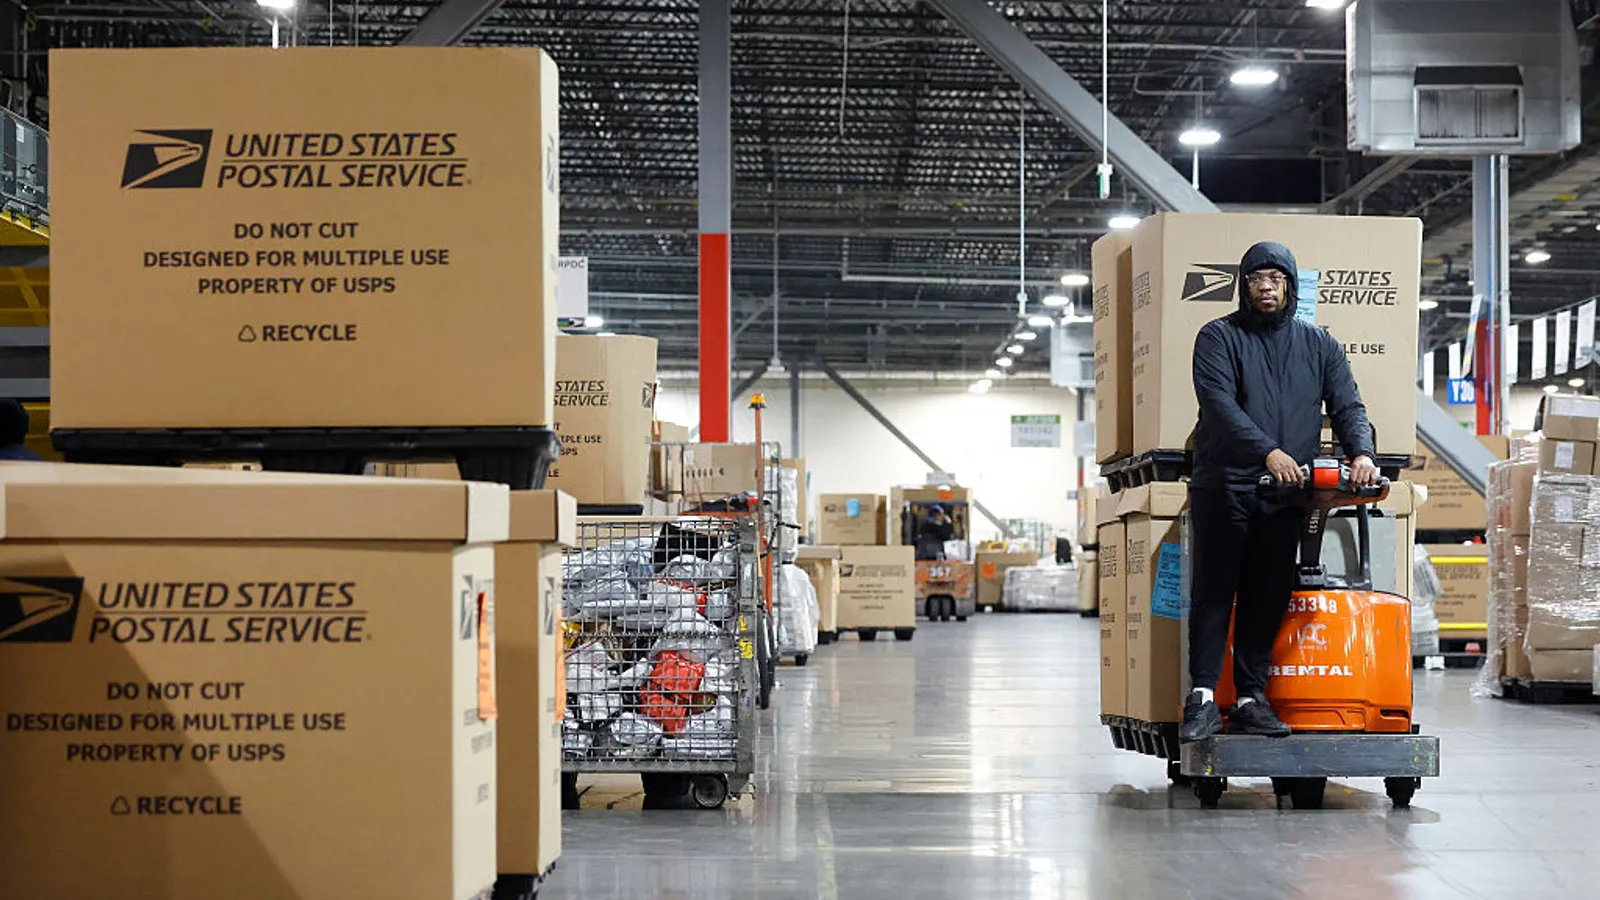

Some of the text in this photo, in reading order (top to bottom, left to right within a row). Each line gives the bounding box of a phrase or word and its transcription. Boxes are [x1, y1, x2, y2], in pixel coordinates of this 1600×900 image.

[225, 133, 457, 157] UNITED STATES
[217, 164, 467, 188] POSTAL SERVICE
[233, 222, 359, 239] DO NOT CUT
[143, 249, 449, 268] DESIGNED FOR MULTIPLE USE
[198, 276, 396, 295] PROPERTY OF USPS
[1323, 270, 1392, 287] STATES
[1317, 289, 1397, 306] SERVICE
[262, 324, 357, 342] RECYCLE
[1360, 343, 1386, 355] USE
[555, 380, 605, 392] STATES
[584, 434, 602, 444] USE
[559, 447, 578, 456] SPS
[99, 582, 356, 608] UNITED STATES
[89, 616, 366, 643] POSTAL SERVICE
[1268, 665, 1354, 676] RENTAL
[107, 682, 245, 700] DO NOT CUT
[6, 713, 347, 732] DESIGNED FOR MULTIPLE USE
[66, 744, 286, 763] PROPERTY OF USPS
[137, 796, 243, 815] RECYCLE
